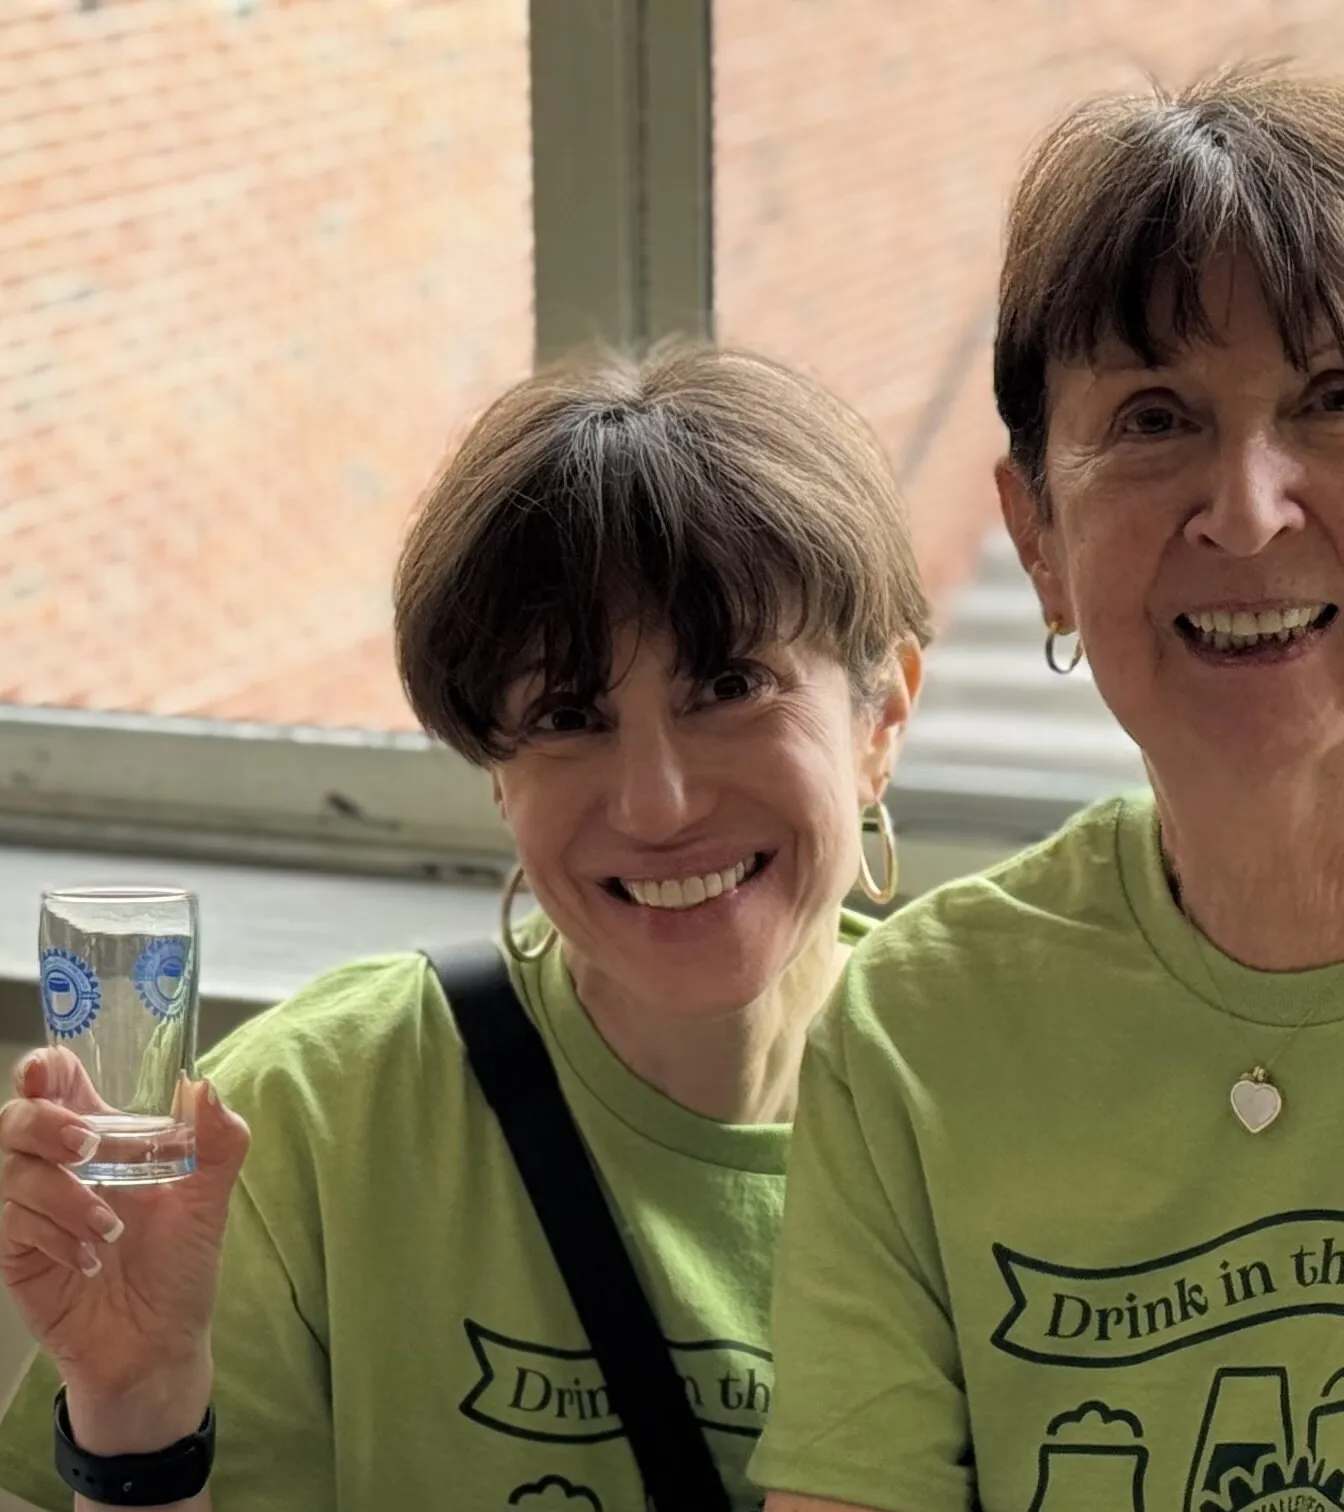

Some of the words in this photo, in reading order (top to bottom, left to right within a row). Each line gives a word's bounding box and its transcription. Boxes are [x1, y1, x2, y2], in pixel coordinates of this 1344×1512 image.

[1044, 1284, 1208, 1343] Drink
[1219, 1260, 1274, 1306] in
[507, 1366, 610, 1419] Drin
[717, 1367, 771, 1414] th
